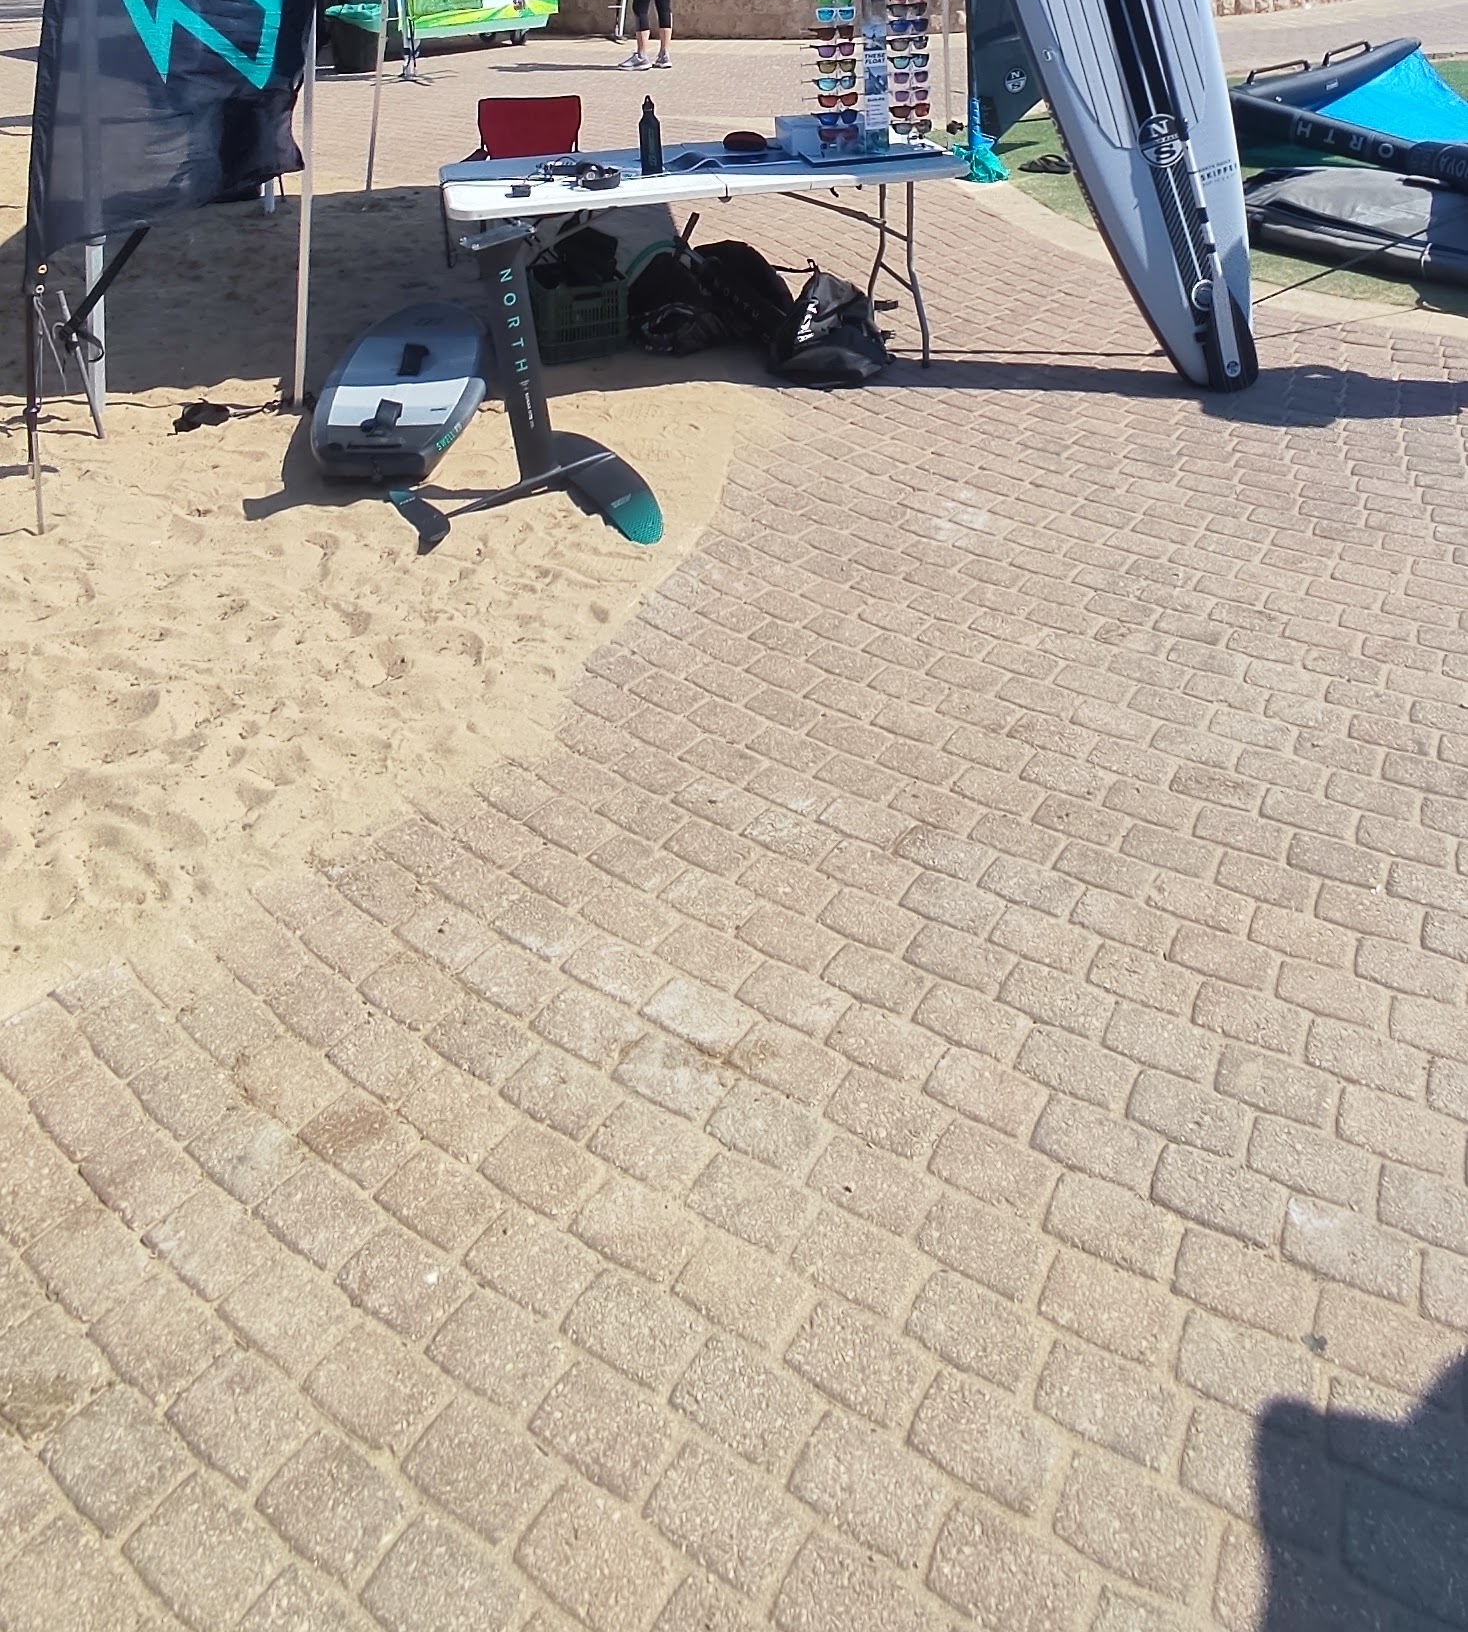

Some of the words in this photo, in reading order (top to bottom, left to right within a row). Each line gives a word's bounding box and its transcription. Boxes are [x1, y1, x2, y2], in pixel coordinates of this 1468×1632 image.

[1149, 119, 1170, 138] N
[1296, 120, 1395, 159] ORTH
[1154, 143, 1177, 162] S
[500, 268, 528, 373] NORTH
